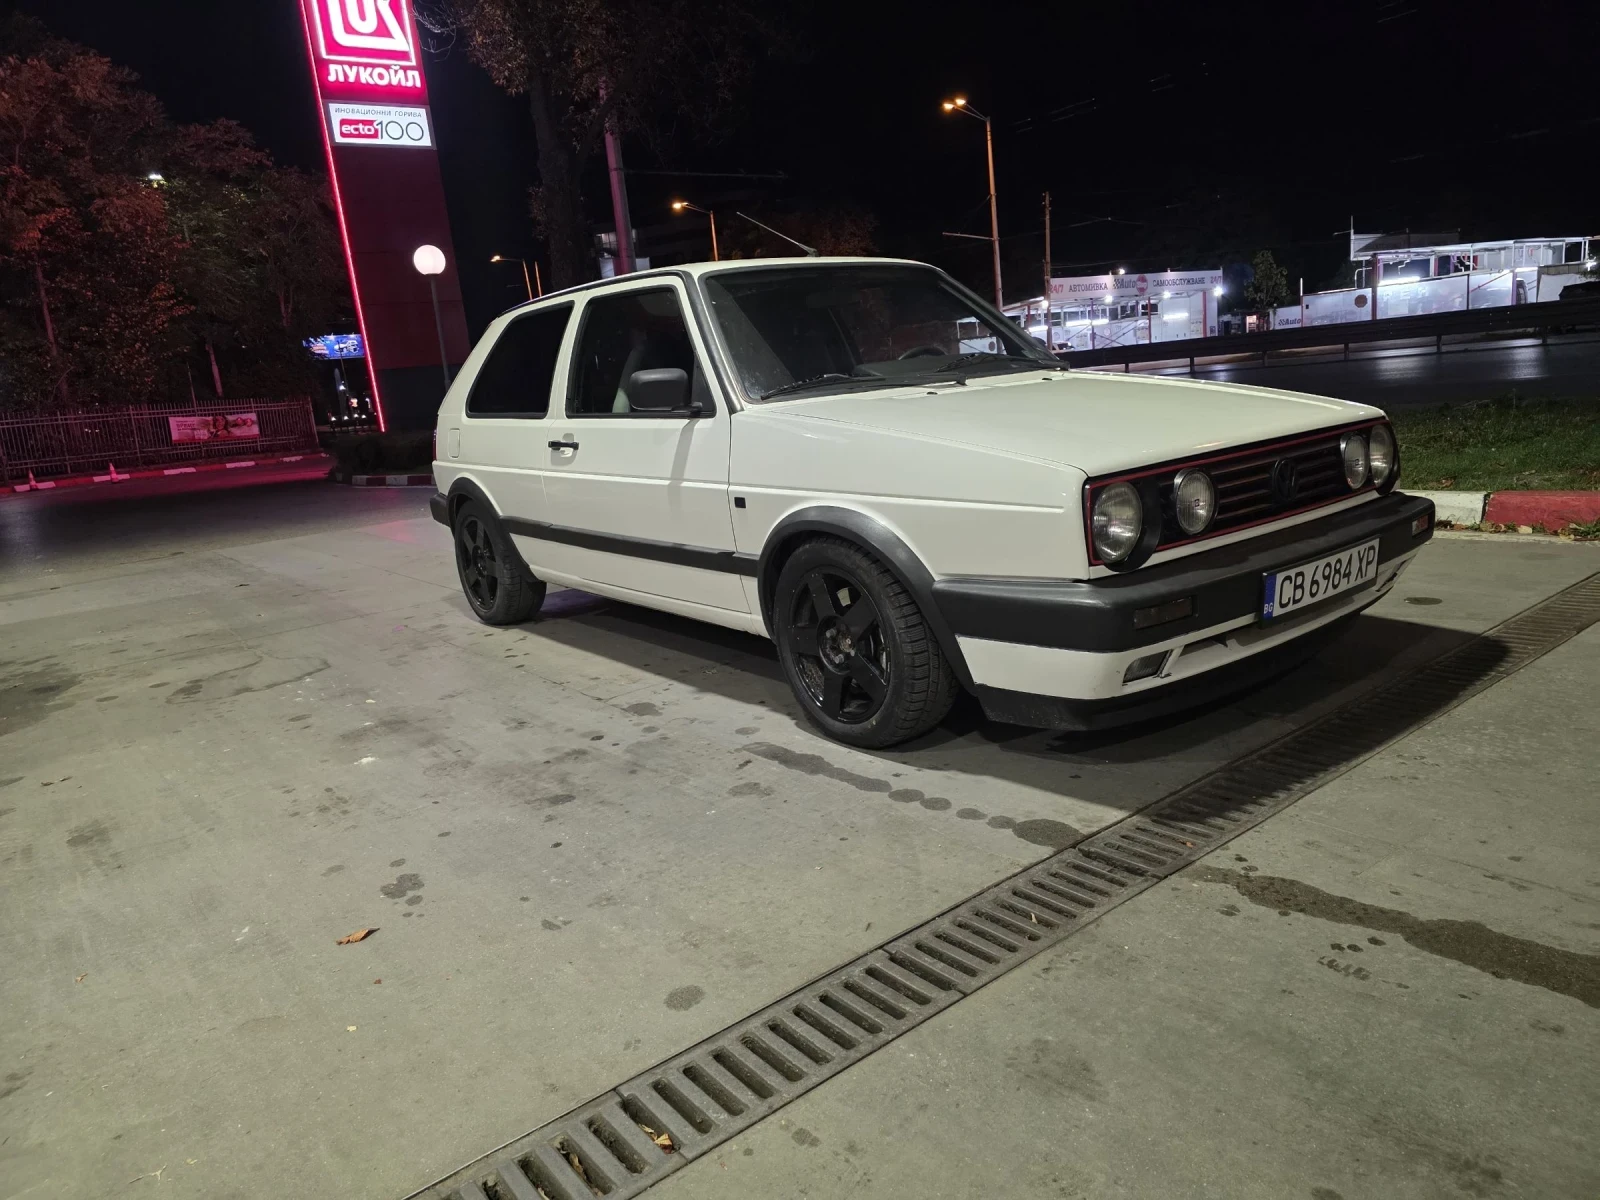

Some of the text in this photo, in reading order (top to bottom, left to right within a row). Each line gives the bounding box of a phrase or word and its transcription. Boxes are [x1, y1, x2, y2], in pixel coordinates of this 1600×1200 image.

[328, 64, 421, 88] ЛУКОЙЛ
[334, 107, 422, 118] ИНОВАЦИОННИ ГОРИВА
[341, 120, 424, 141] ecto 100
[1069, 283, 1108, 292] АВТОМИВКА
[1120, 278, 1136, 289] Auto
[1278, 545, 1376, 609] CB 6984 XP
[1263, 603, 1274, 614] BG
